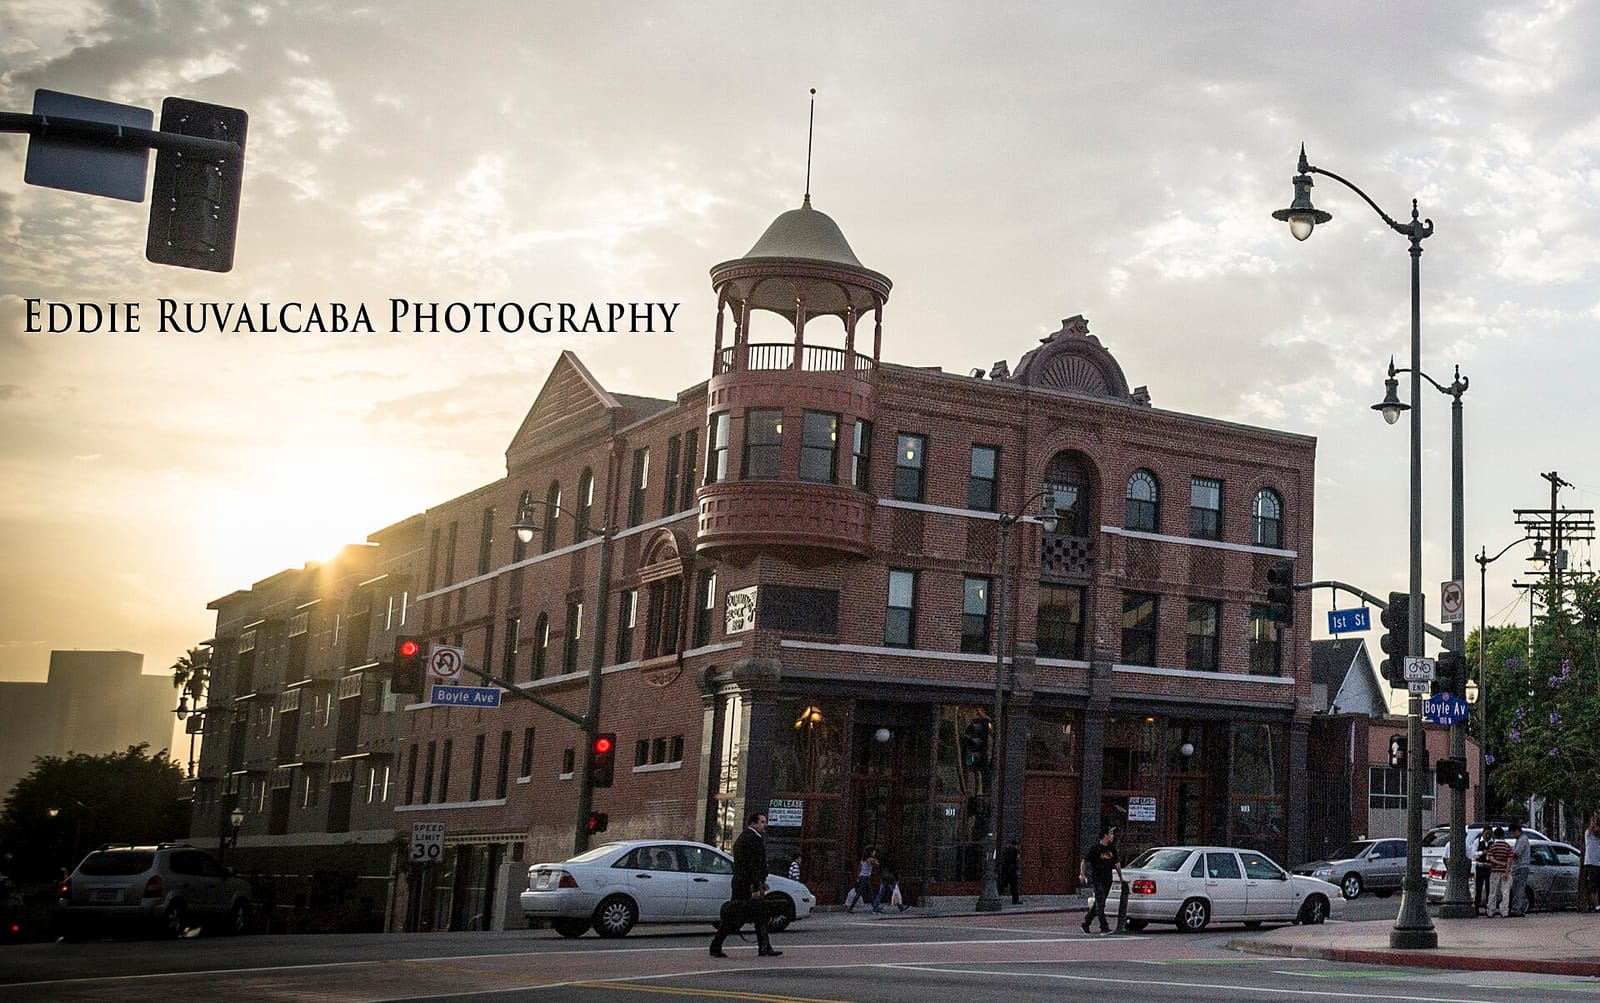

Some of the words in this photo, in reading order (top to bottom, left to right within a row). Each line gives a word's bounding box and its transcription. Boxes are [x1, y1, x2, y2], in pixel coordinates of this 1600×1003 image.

[1333, 616, 1346, 629] 1st
[1355, 613, 1365, 626] St
[1412, 684, 1426, 692] END
[437, 690, 470, 702] Boyle
[475, 692, 494, 703] Ave
[1425, 701, 1450, 717] Boyle
[1454, 702, 1466, 716] Av
[769, 799, 783, 807] FOR
[783, 799, 804, 808] LEASE
[413, 824, 444, 832] SPEED
[415, 833, 442, 841] LIMIT
[412, 843, 442, 859] 30
